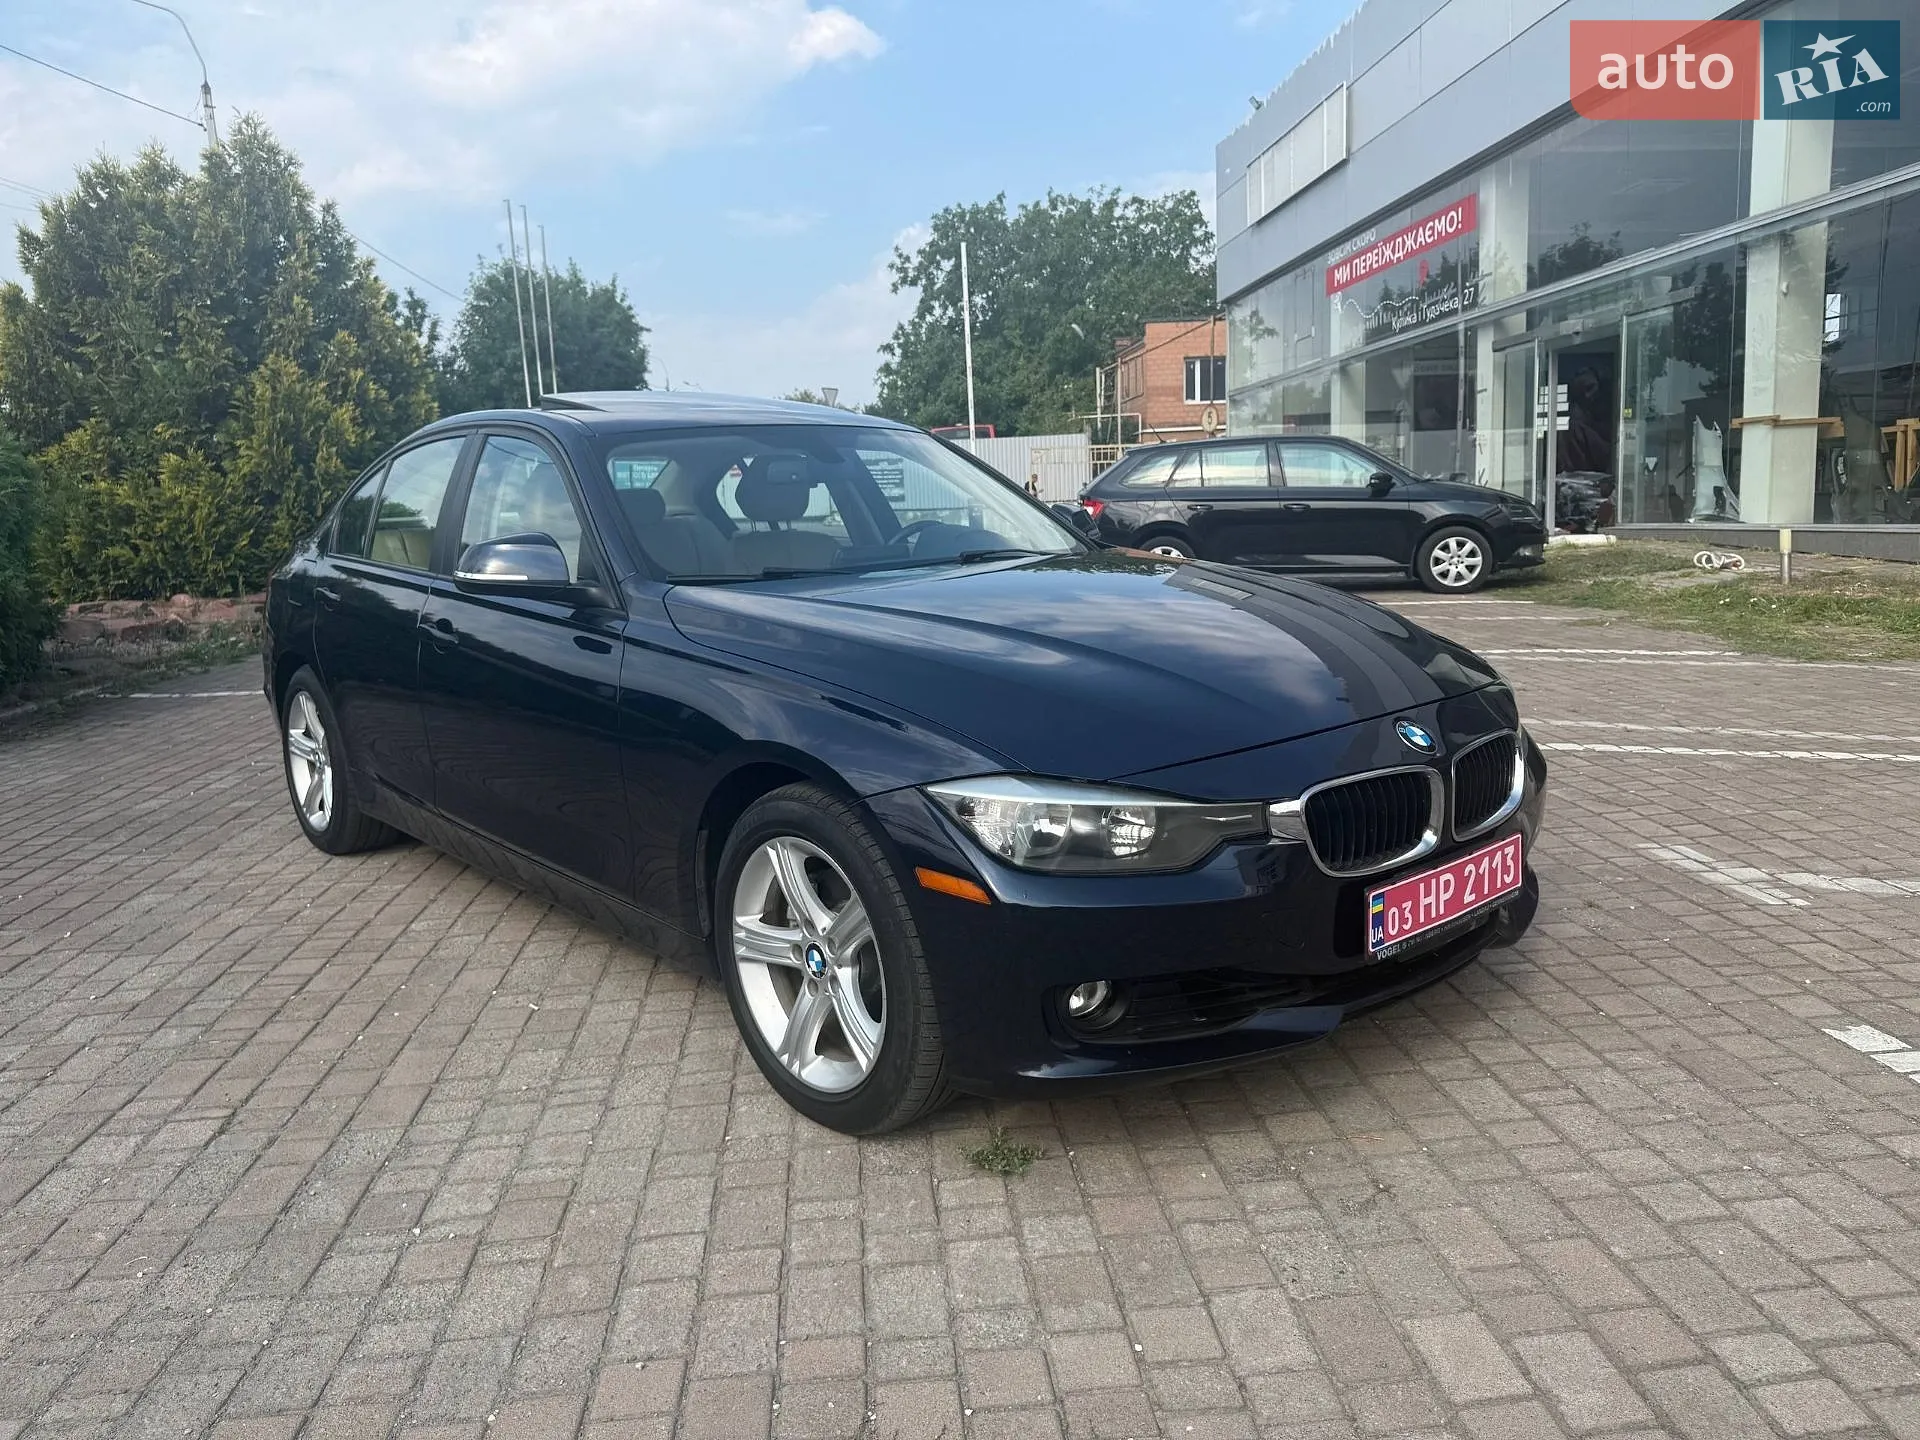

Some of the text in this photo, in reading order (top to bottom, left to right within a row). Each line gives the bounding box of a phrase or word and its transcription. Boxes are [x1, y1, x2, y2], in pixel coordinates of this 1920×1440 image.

[1334, 206, 1463, 288] МИ ПЕРЕЇЖДЖАЄМО!
[1463, 287, 1475, 305] 27
[1207, 411, 1213, 425] 5
[1388, 900, 1413, 936] 03
[1419, 872, 1455, 923] HP
[1463, 845, 1515, 905] 2113
[1371, 926, 1384, 943] UA
